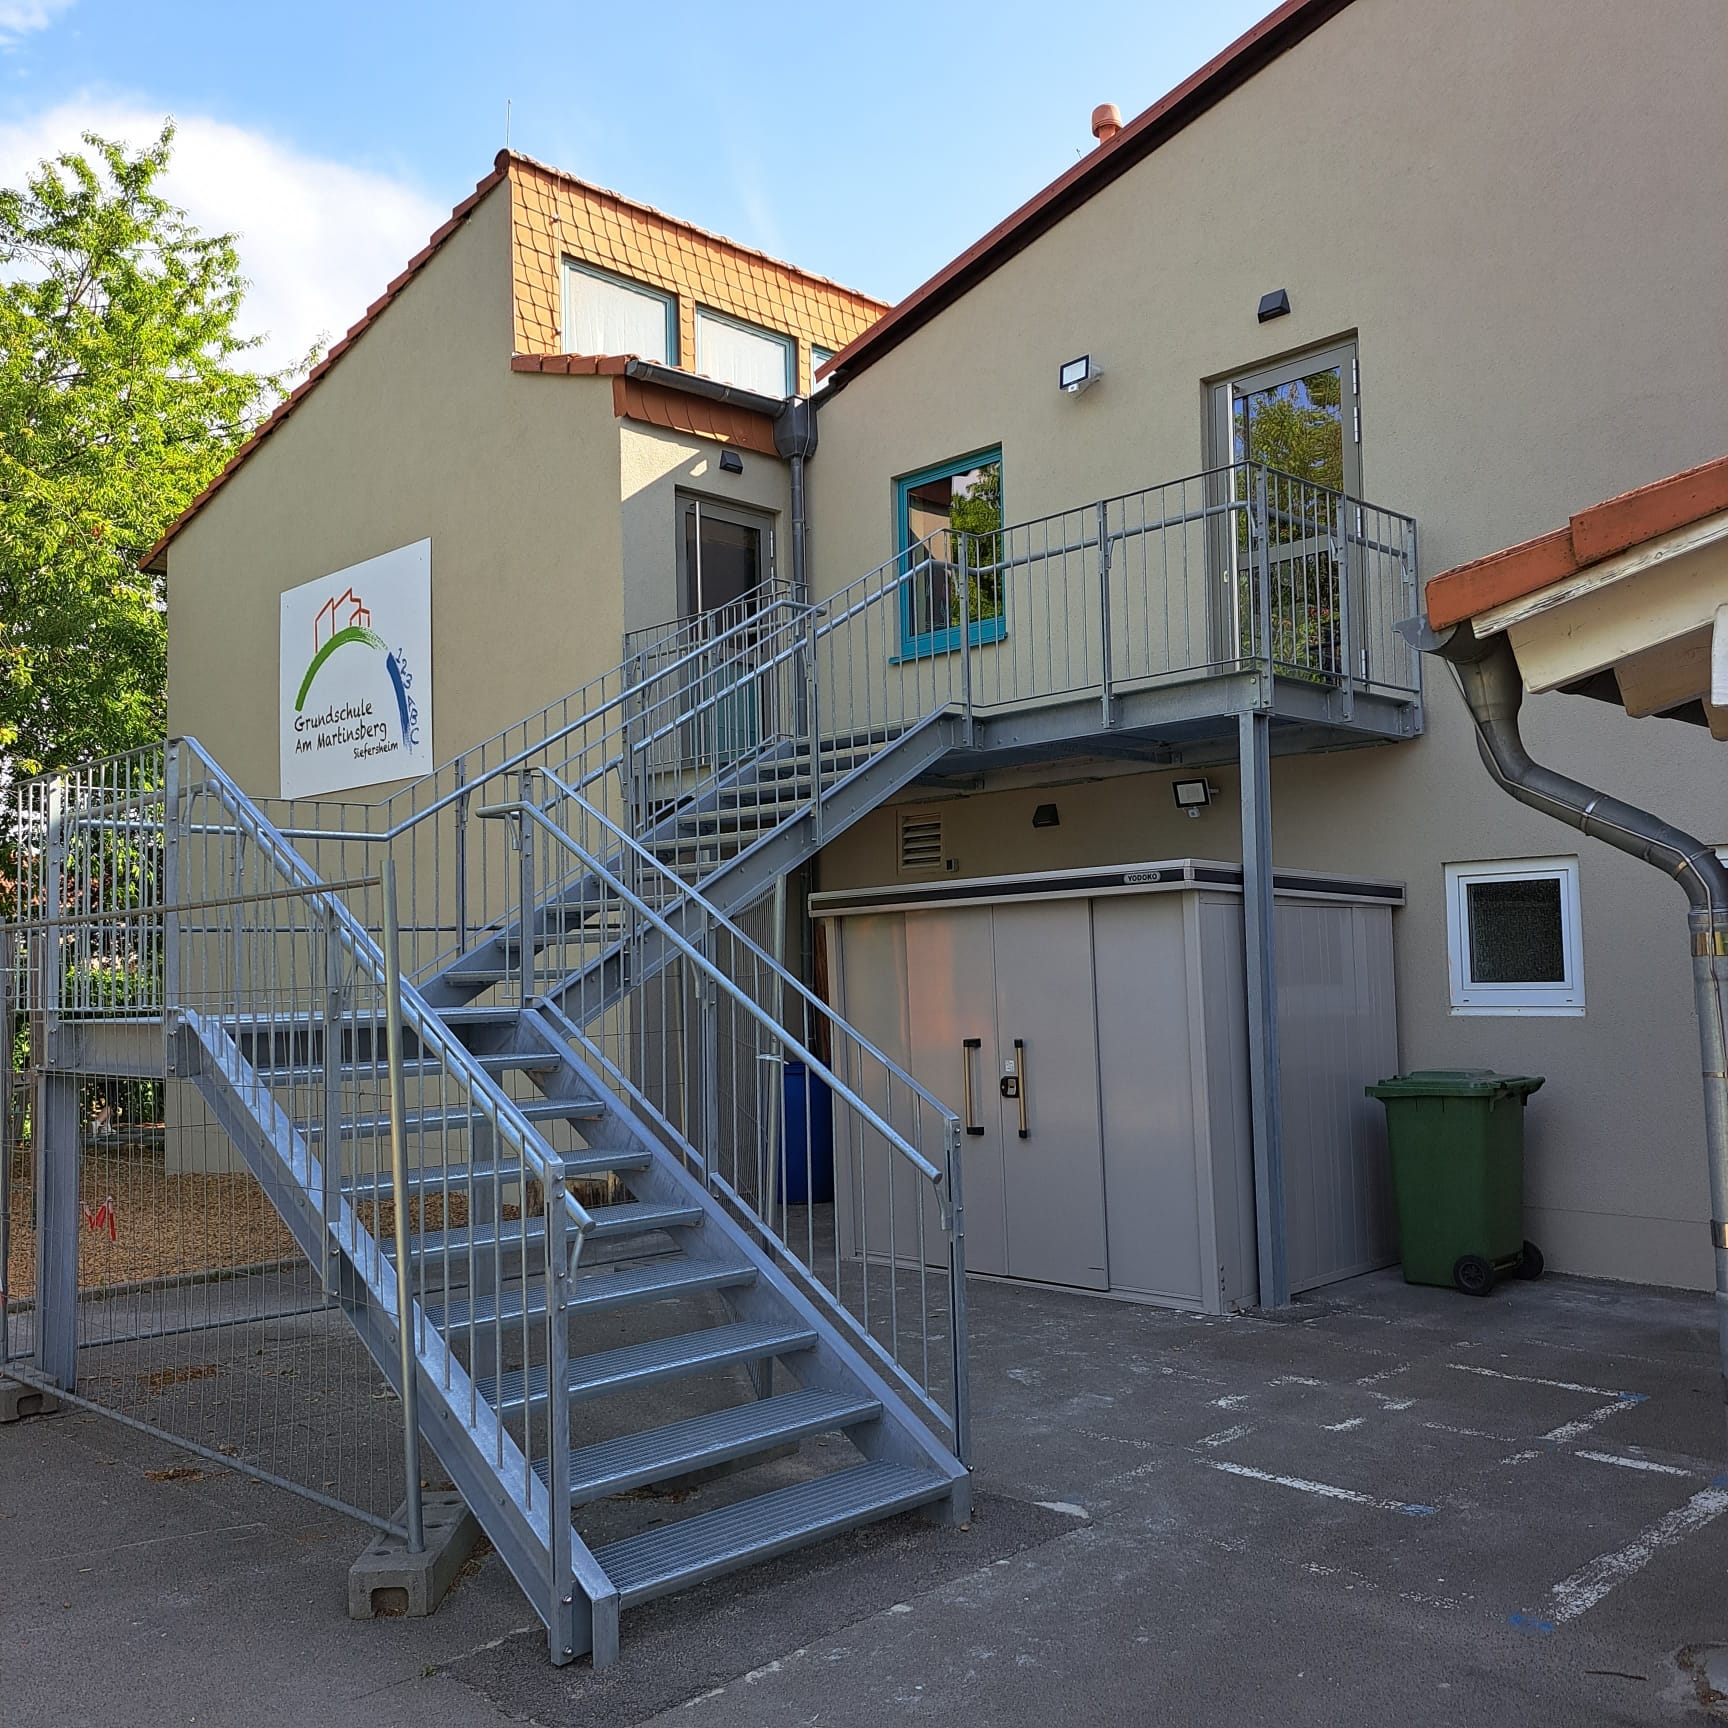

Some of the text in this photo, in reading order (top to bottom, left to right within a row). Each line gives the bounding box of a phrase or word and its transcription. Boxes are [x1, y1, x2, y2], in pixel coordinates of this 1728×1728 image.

[294, 698, 373, 732] Grundschule
[295, 718, 387, 755] Am Martinsberg
[352, 741, 399, 760] Siefersheim
[1127, 873, 1158, 882] YODOKO
